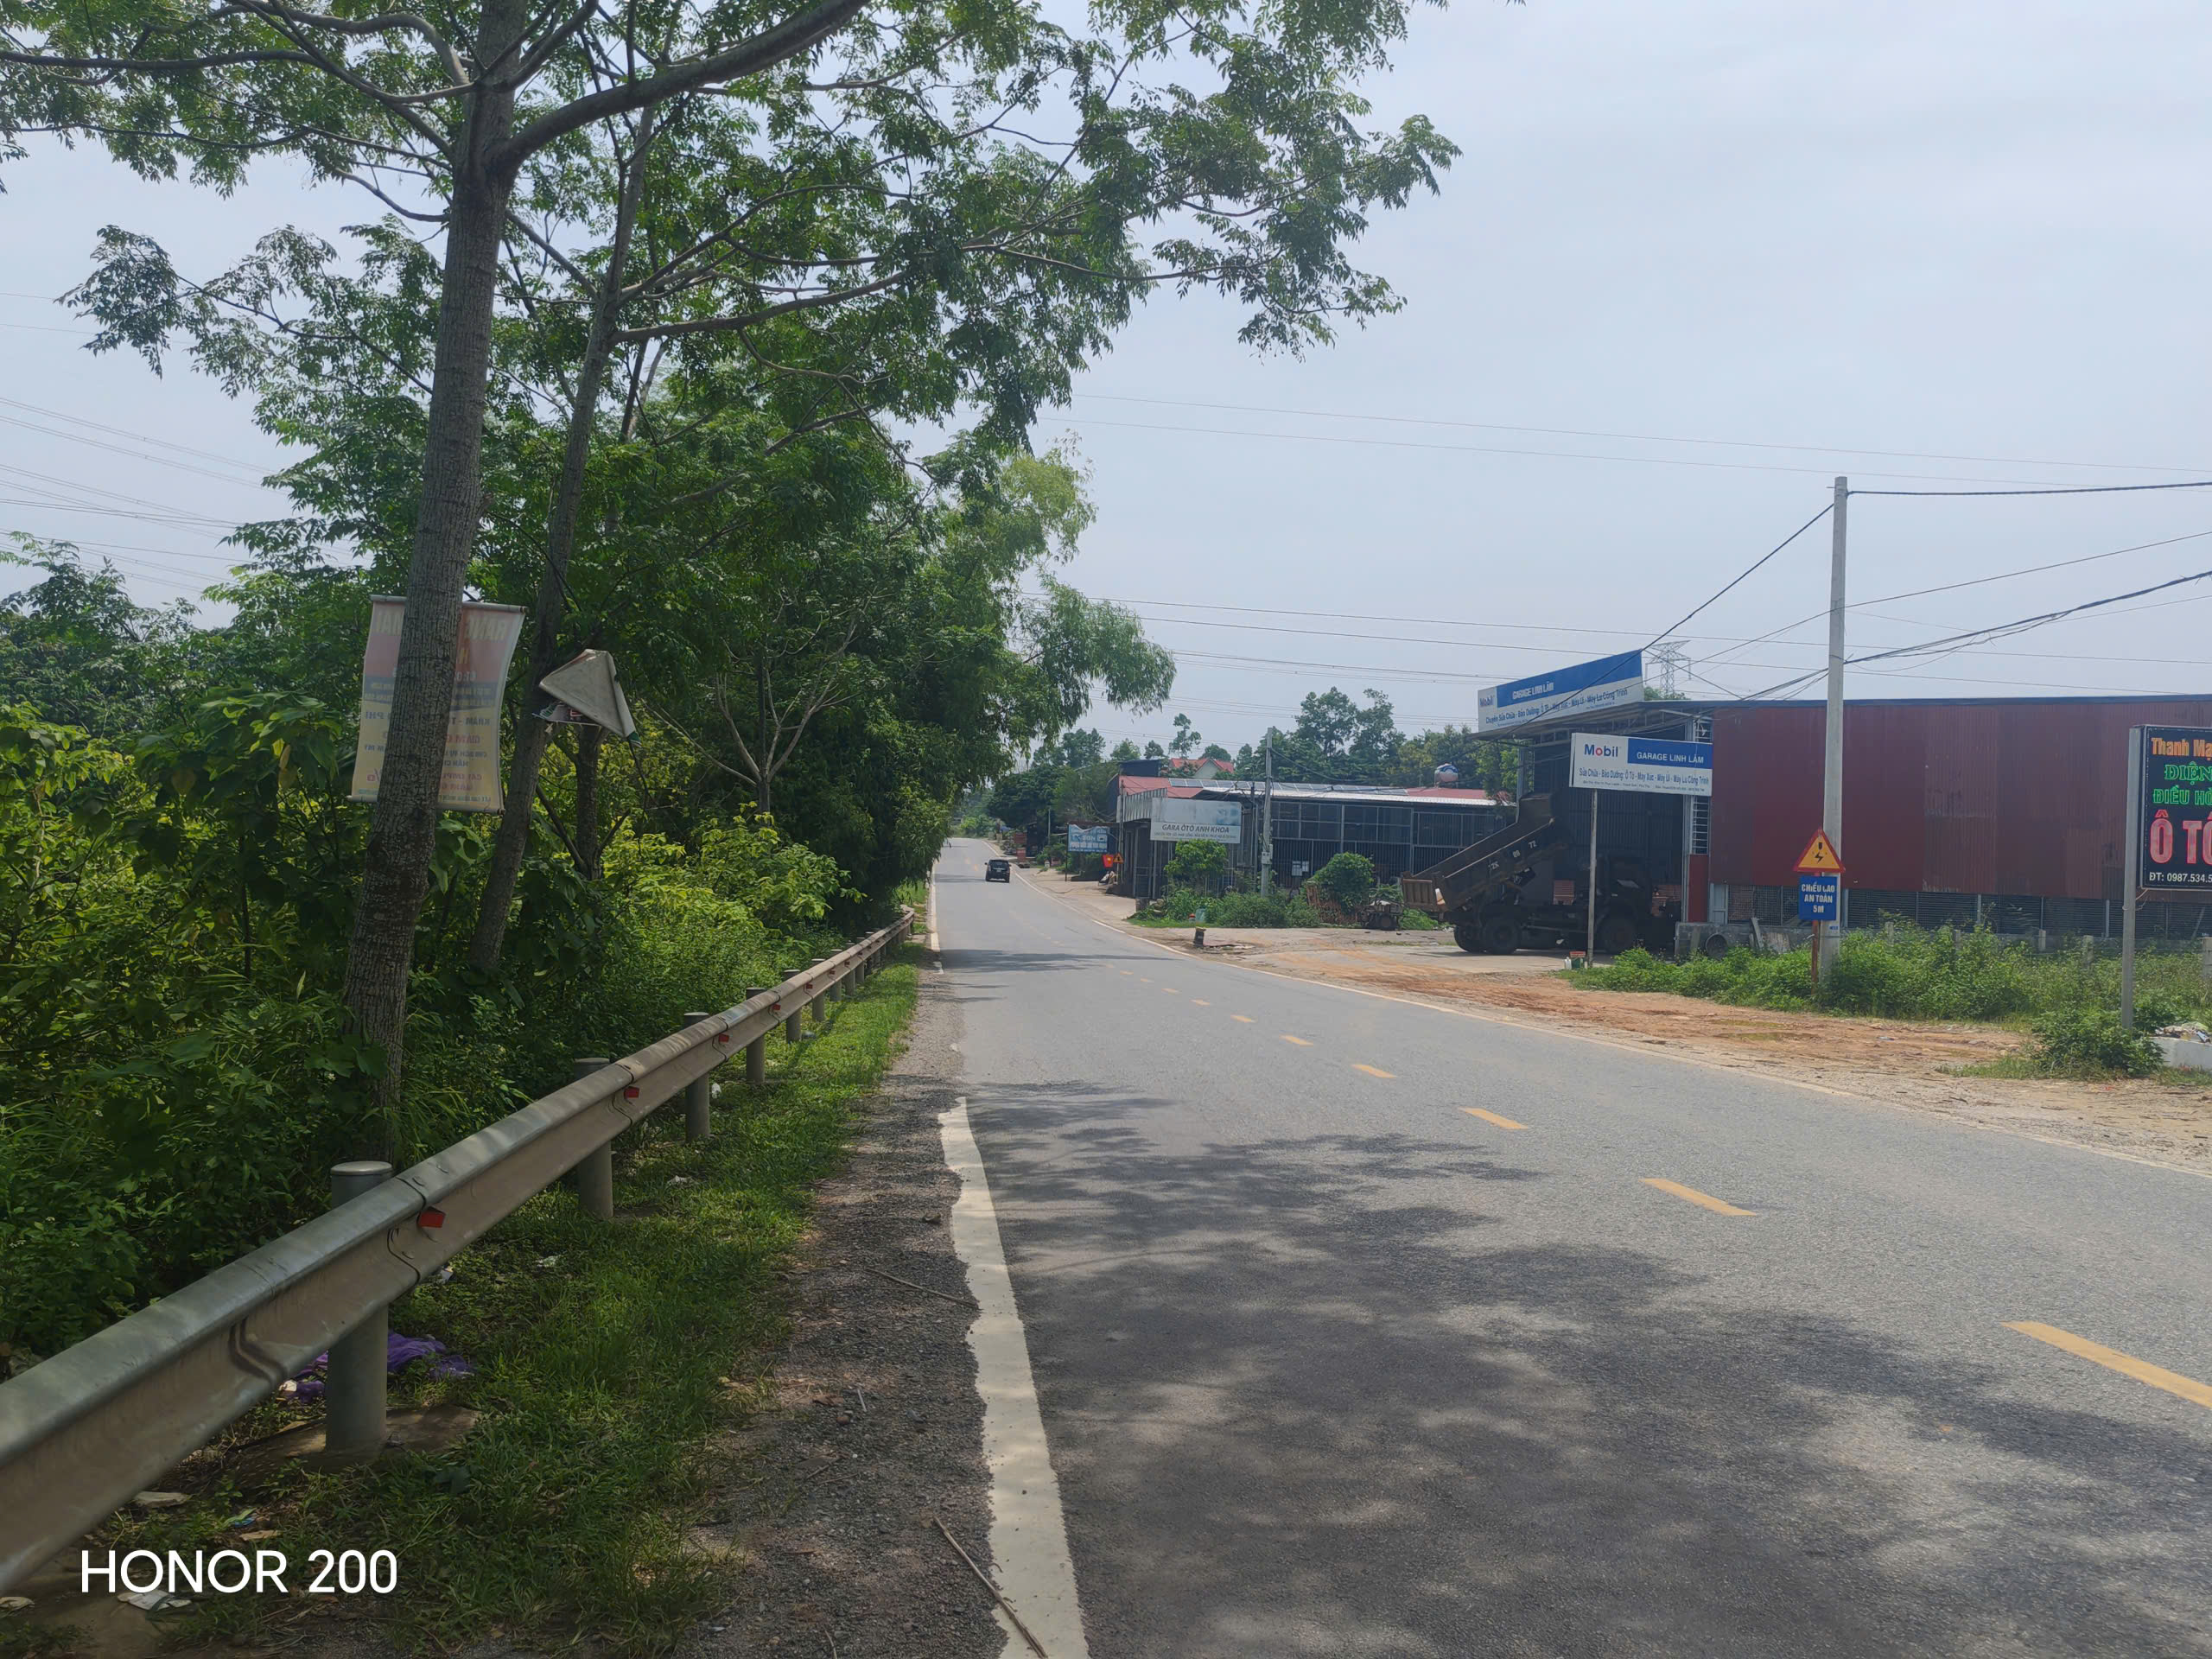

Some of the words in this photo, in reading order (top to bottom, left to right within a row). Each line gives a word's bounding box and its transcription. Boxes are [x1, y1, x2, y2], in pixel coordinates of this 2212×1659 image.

[1584, 744, 1618, 757] Mobil
[2151, 737, 2190, 756] Thanh
[1637, 751, 1668, 761] GARAGE
[1669, 753, 1686, 762] LINH
[2164, 761, 2212, 785] ĐIỆN
[2150, 809, 2173, 864] Ô
[2149, 872, 2164, 881] ĐT:
[1804, 893, 1815, 903] AN
[1815, 893, 1833, 904] TOÀN
[1813, 905, 1824, 913] 5M
